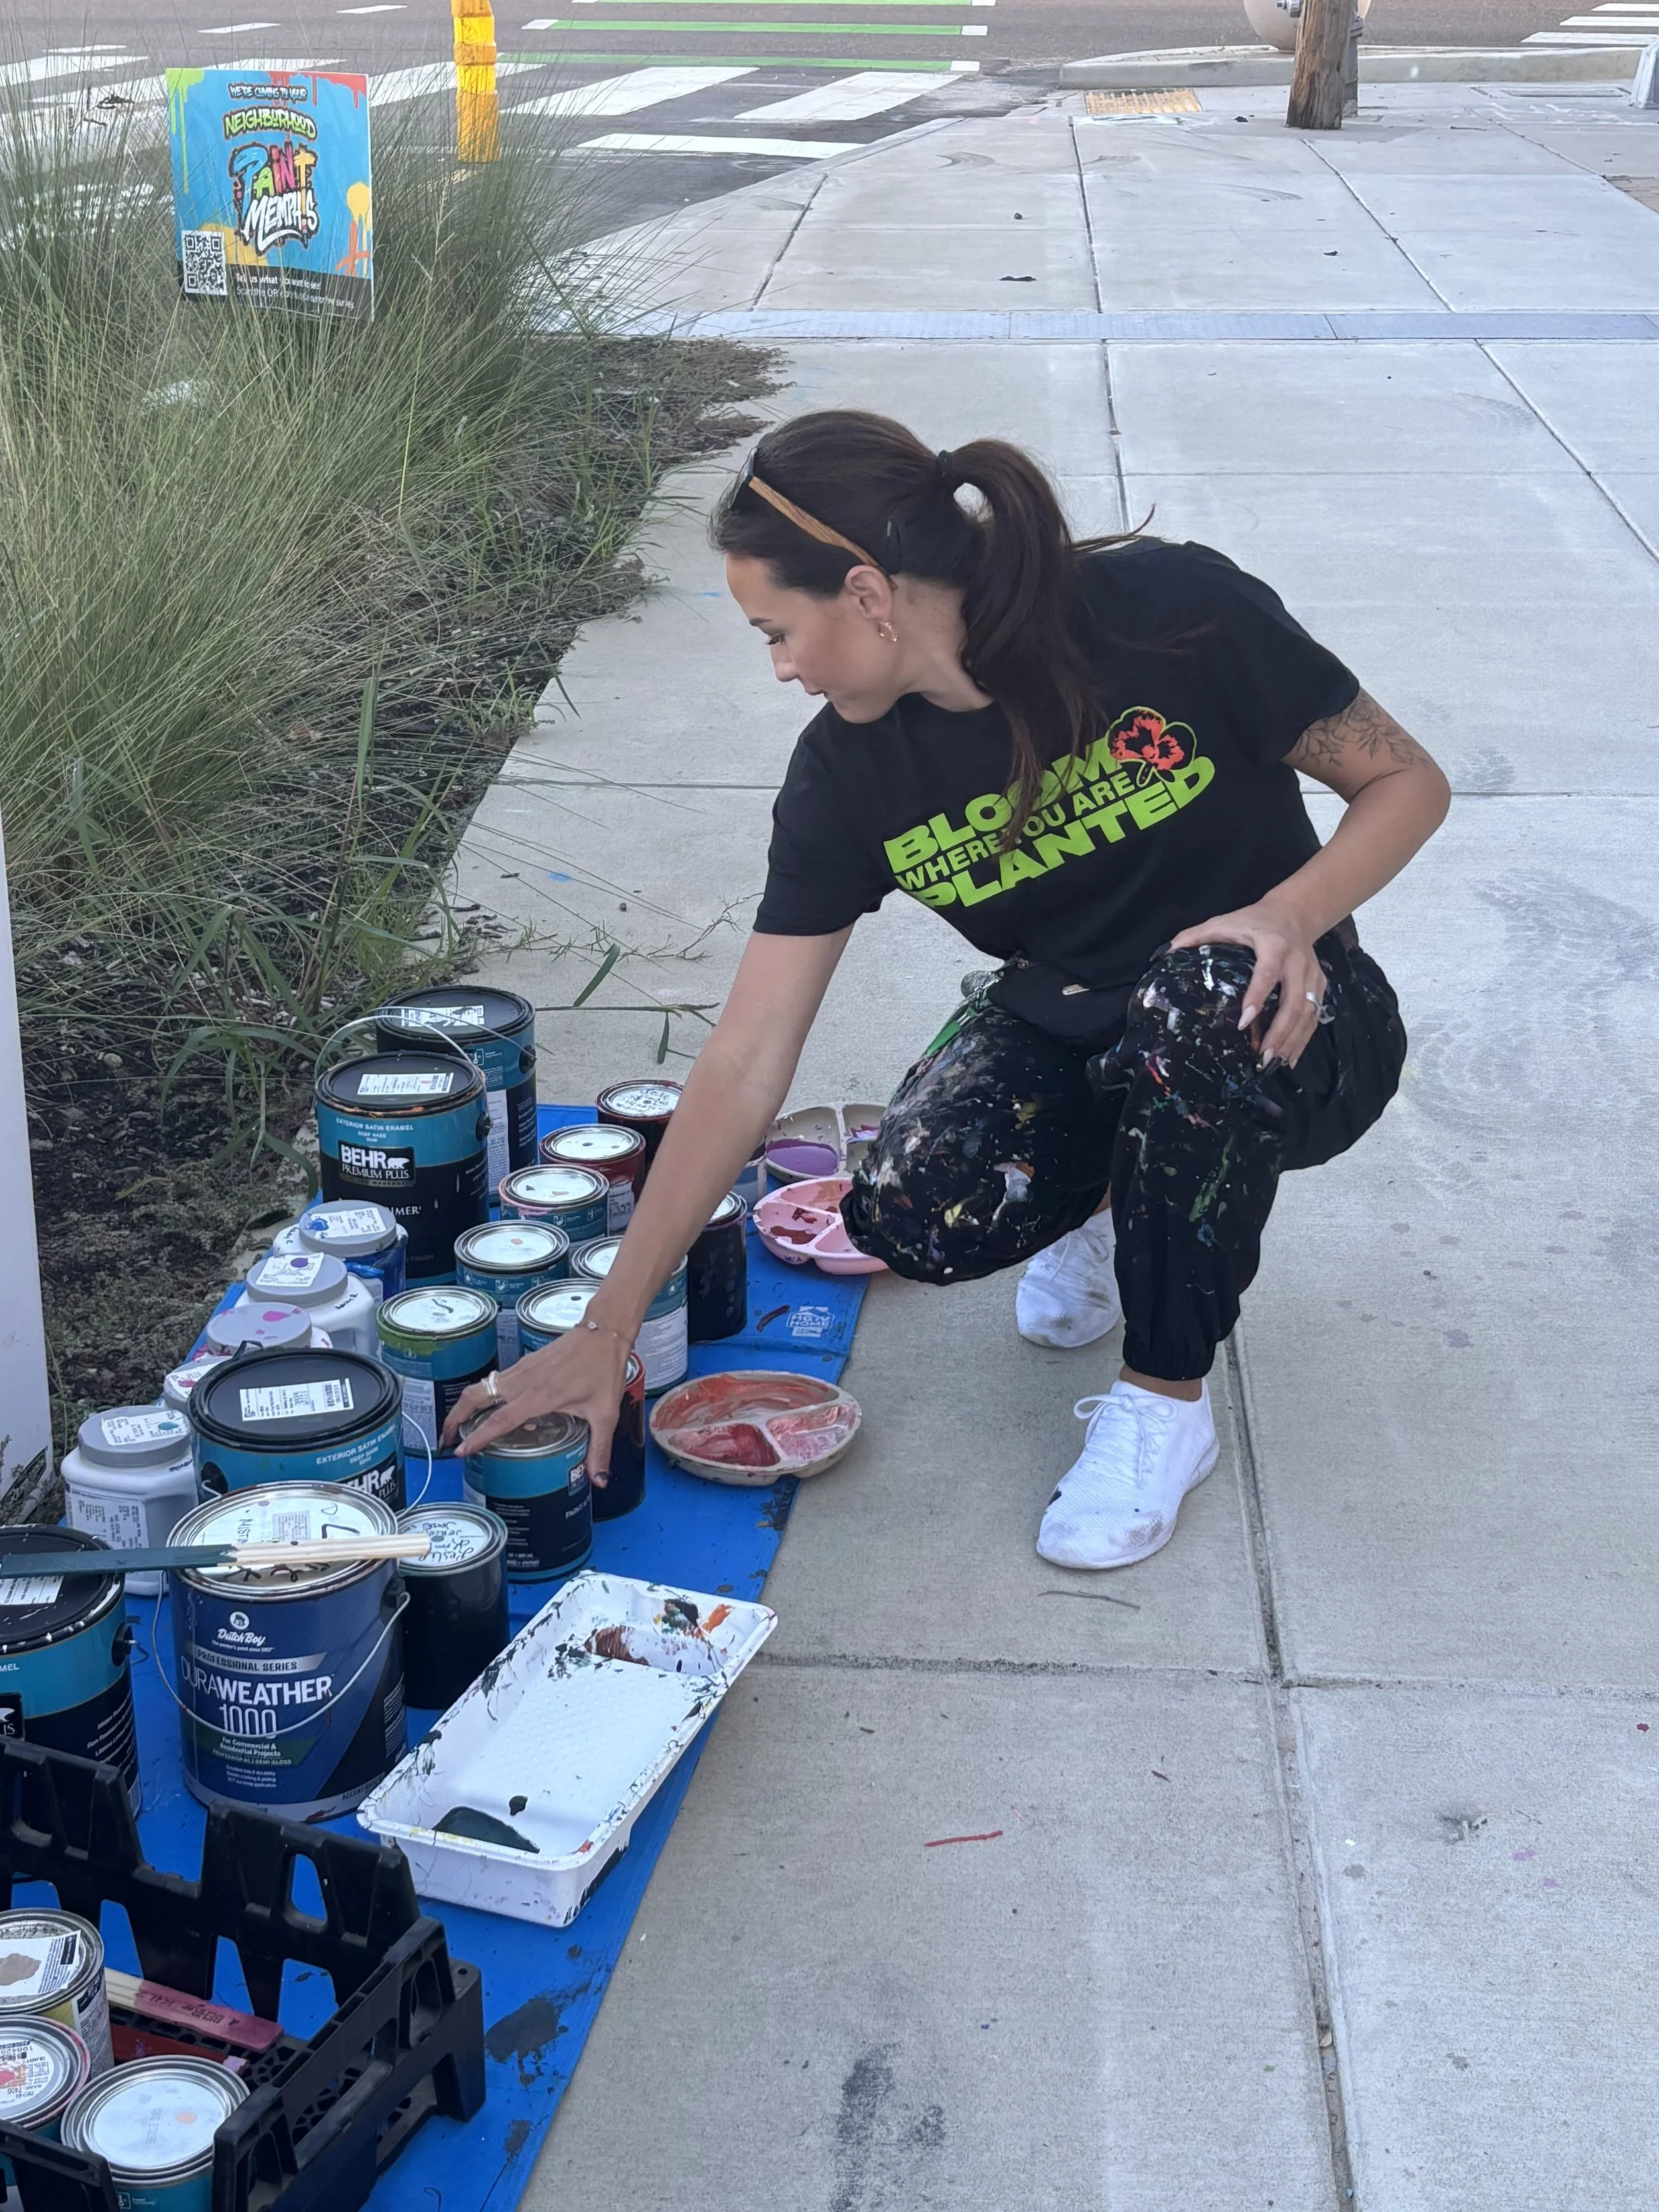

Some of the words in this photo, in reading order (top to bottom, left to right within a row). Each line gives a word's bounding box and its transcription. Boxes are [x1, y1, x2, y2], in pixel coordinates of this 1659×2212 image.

[225, 108, 317, 139] NEIGHBORHOOD
[883, 737, 1123, 874] BLOOM
[895, 832, 1007, 891] WHERE
[1014, 804, 1066, 845] OU
[1073, 771, 1135, 816] ARE
[910, 756, 1216, 908] PLANTED
[336, 1117, 364, 1129] EXTERIOR
[340, 1144, 388, 1169] BEHR
[342, 1163, 382, 1179] PREMIUM
[386, 1169, 409, 1179] PLUS
[391, 1206, 419, 1216] IMER
[316, 1447, 356, 1465] EXTERIOR
[358, 1439, 377, 1451] SATIN
[217, 1627, 245, 1643] Dutch
[244, 1632, 266, 1647] Boy
[198, 1651, 260, 1671] PROFESSIONAL
[262, 1661, 297, 1671] SERIES
[181, 1655, 333, 1706] DURAWEATHER
[219, 1703, 277, 1739] 1000
[220, 1742, 253, 1755] Residential
[253, 1749, 281, 1758] Projects
[232, 1739, 269, 1749] Commercial
